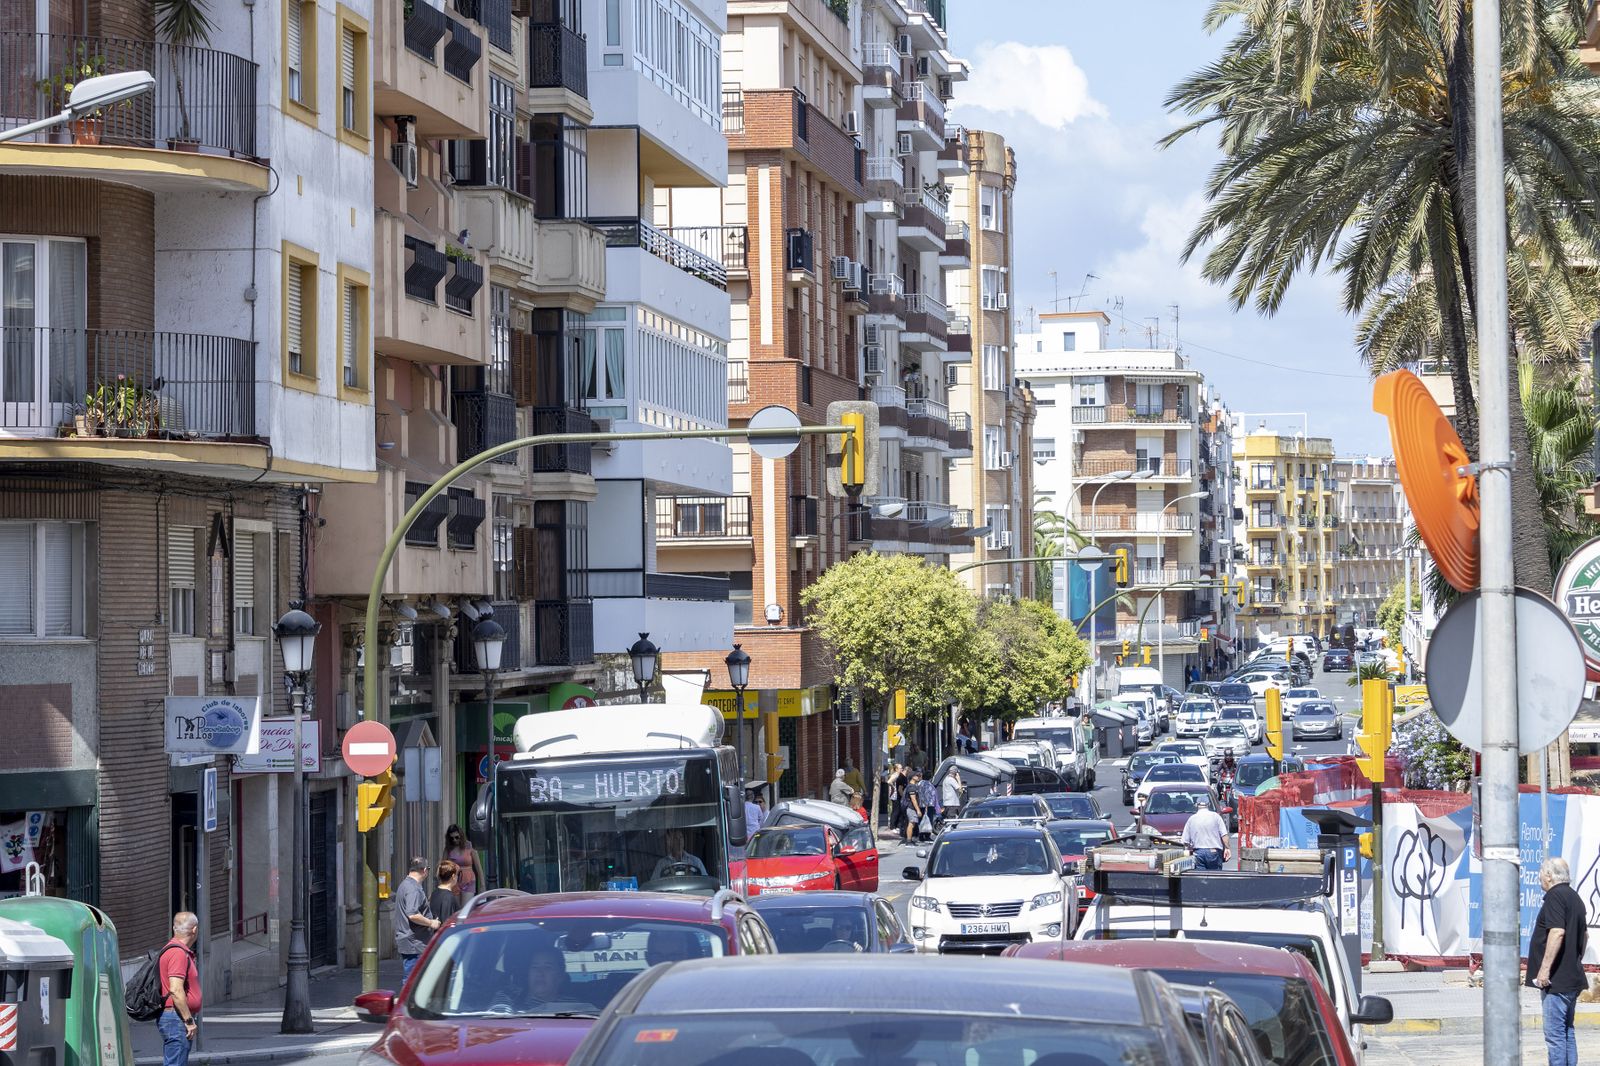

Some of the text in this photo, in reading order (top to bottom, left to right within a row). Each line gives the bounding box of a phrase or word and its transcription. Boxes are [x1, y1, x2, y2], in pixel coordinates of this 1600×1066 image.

[201, 700, 219, 713] Club
[232, 703, 249, 731] labores
[594, 768, 679, 799] HUERTO
[1345, 849, 1355, 865] P
[967, 923, 1008, 934] 2364 HMX
[593, 951, 638, 962] MAN
